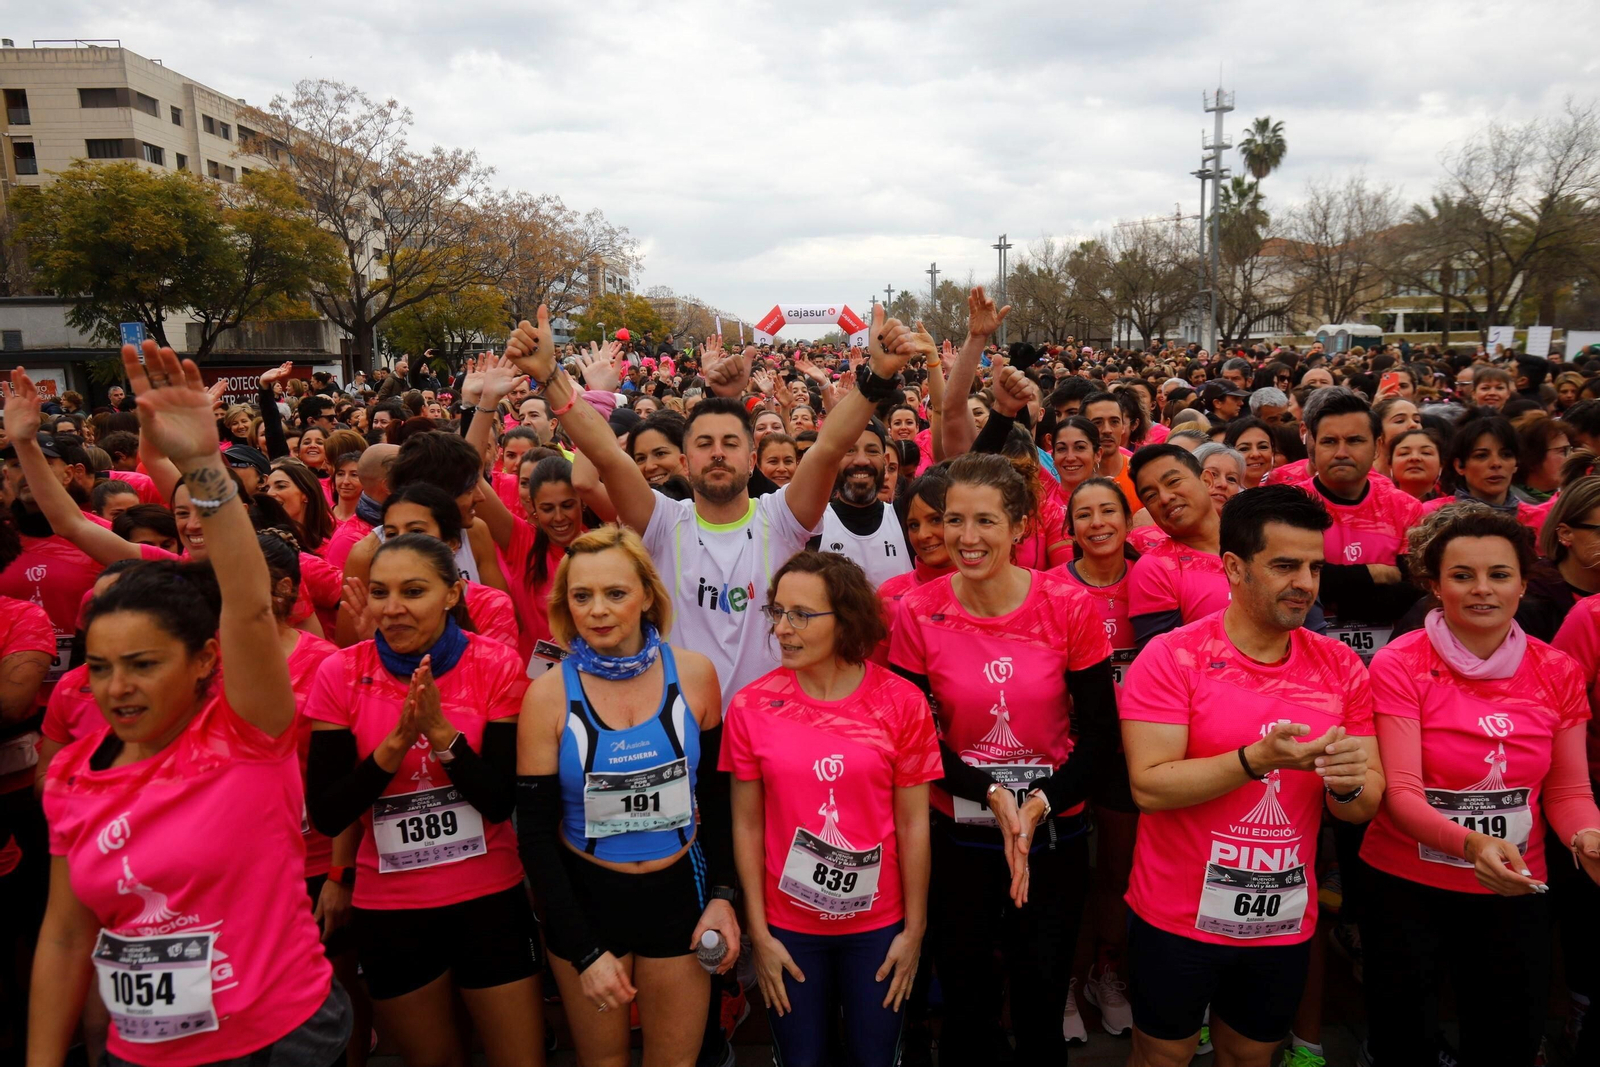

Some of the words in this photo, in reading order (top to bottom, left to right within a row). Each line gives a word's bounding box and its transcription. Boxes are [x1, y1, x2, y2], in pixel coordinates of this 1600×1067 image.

[787, 308, 826, 319] cajasur
[1340, 632, 1374, 650] 545
[609, 750, 658, 764] TROTASIERRA
[973, 743, 988, 751] VIII
[990, 747, 1033, 757] EDICIÓN
[620, 791, 660, 813] 191
[396, 810, 458, 844] 1389
[1229, 824, 1248, 835] VIII
[1210, 840, 1300, 871] PINK
[812, 862, 858, 893] 839
[1234, 893, 1281, 917] 640
[819, 911, 856, 920] 2023
[110, 970, 176, 1007] 1054
